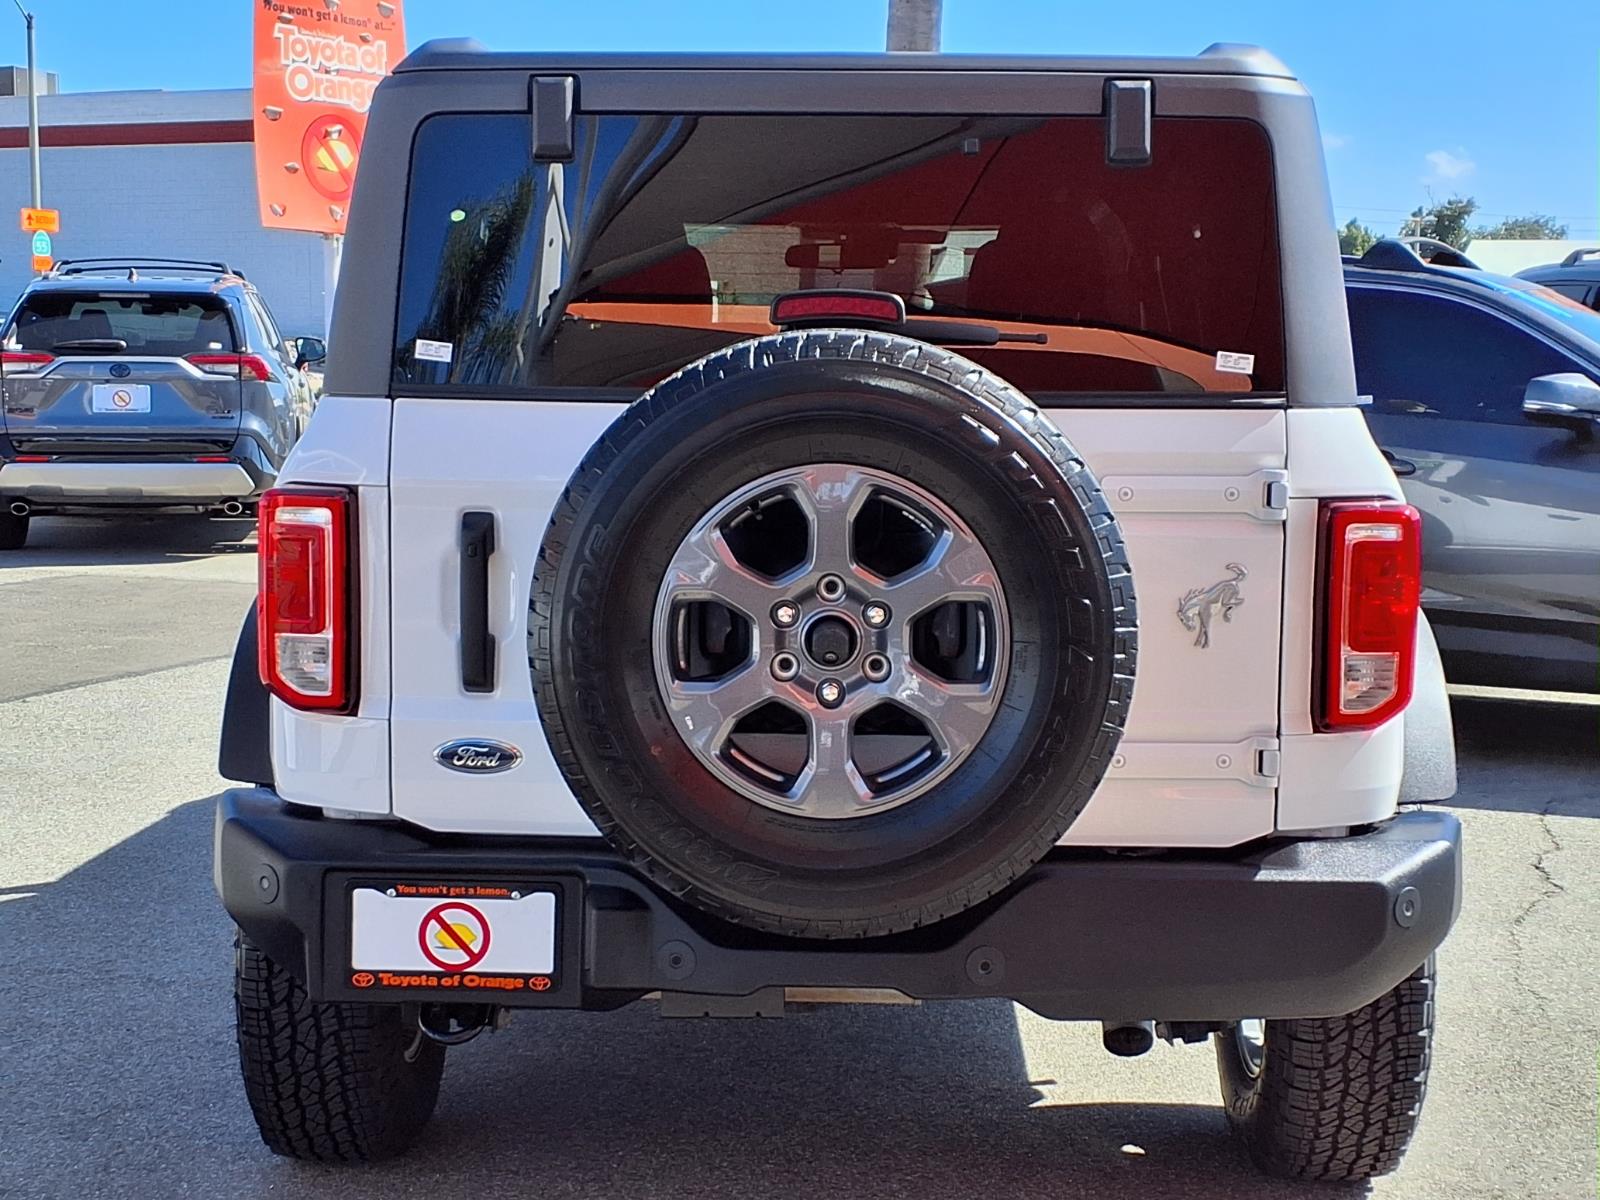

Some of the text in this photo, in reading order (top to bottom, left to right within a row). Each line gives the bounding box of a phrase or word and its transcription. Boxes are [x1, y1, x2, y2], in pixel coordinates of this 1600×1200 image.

[316, 10, 332, 22] get
[273, 22, 387, 75] Toyota of
[452, 745, 501, 767] Ford
[396, 884, 417, 894] You
[417, 885, 448, 895] won't
[449, 886, 466, 897] get
[467, 887, 475, 895] a
[378, 972, 525, 990] Toyota of Orange
